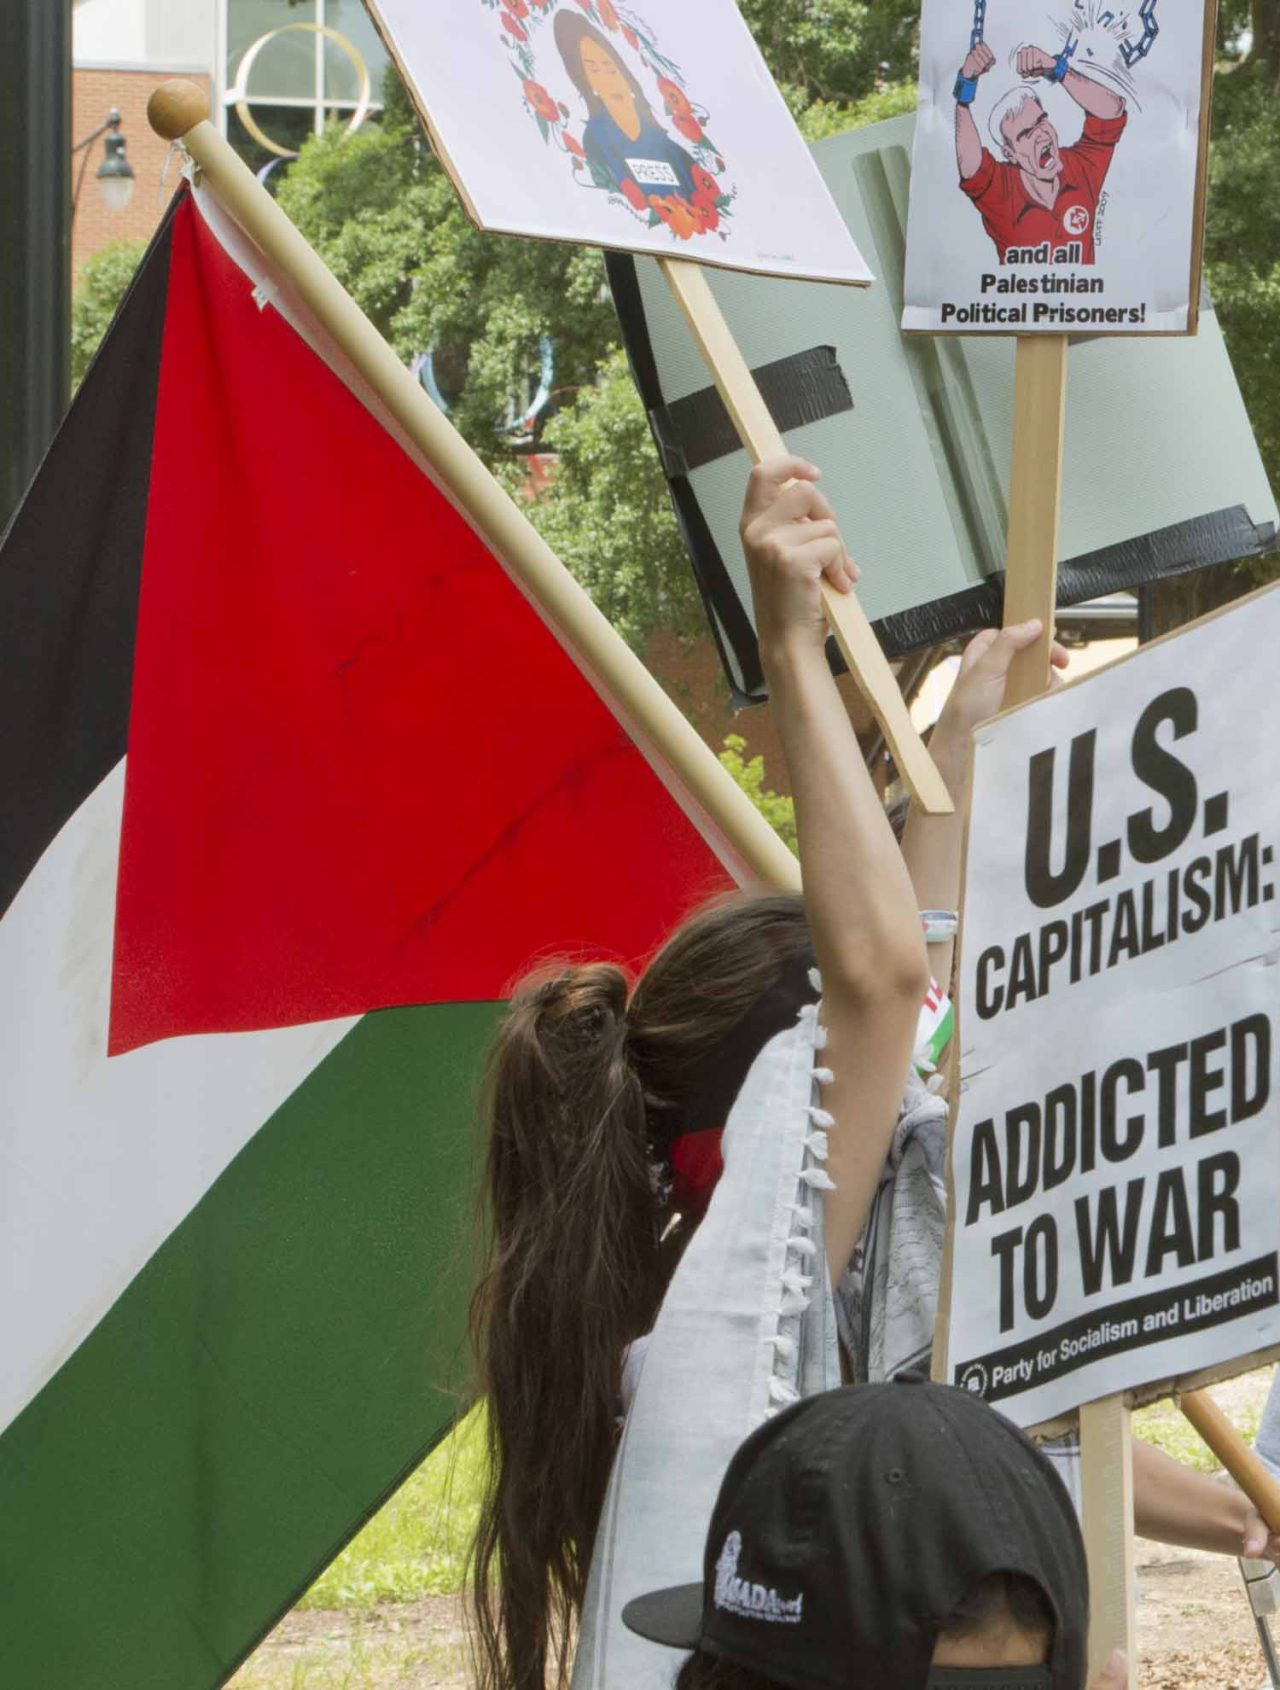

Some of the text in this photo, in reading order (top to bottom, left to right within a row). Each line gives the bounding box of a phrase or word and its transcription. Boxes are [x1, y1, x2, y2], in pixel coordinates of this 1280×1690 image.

[941, 302, 1146, 323] Political Prisoners!
[980, 273, 1104, 294] Palestinian
[1007, 244, 1080, 264] and all
[1025, 686, 1229, 909] U.S.
[976, 833, 1275, 1021] CAPITALISM:
[965, 1013, 1271, 1226] ADDICTED
[991, 1150, 1242, 1334] TO WAR
[992, 1360, 1034, 1388] Party
[1037, 1348, 1058, 1372] for
[1060, 1318, 1138, 1360] Socialism
[1143, 1303, 1179, 1332] and
[1184, 1275, 1273, 1320] Liberation
